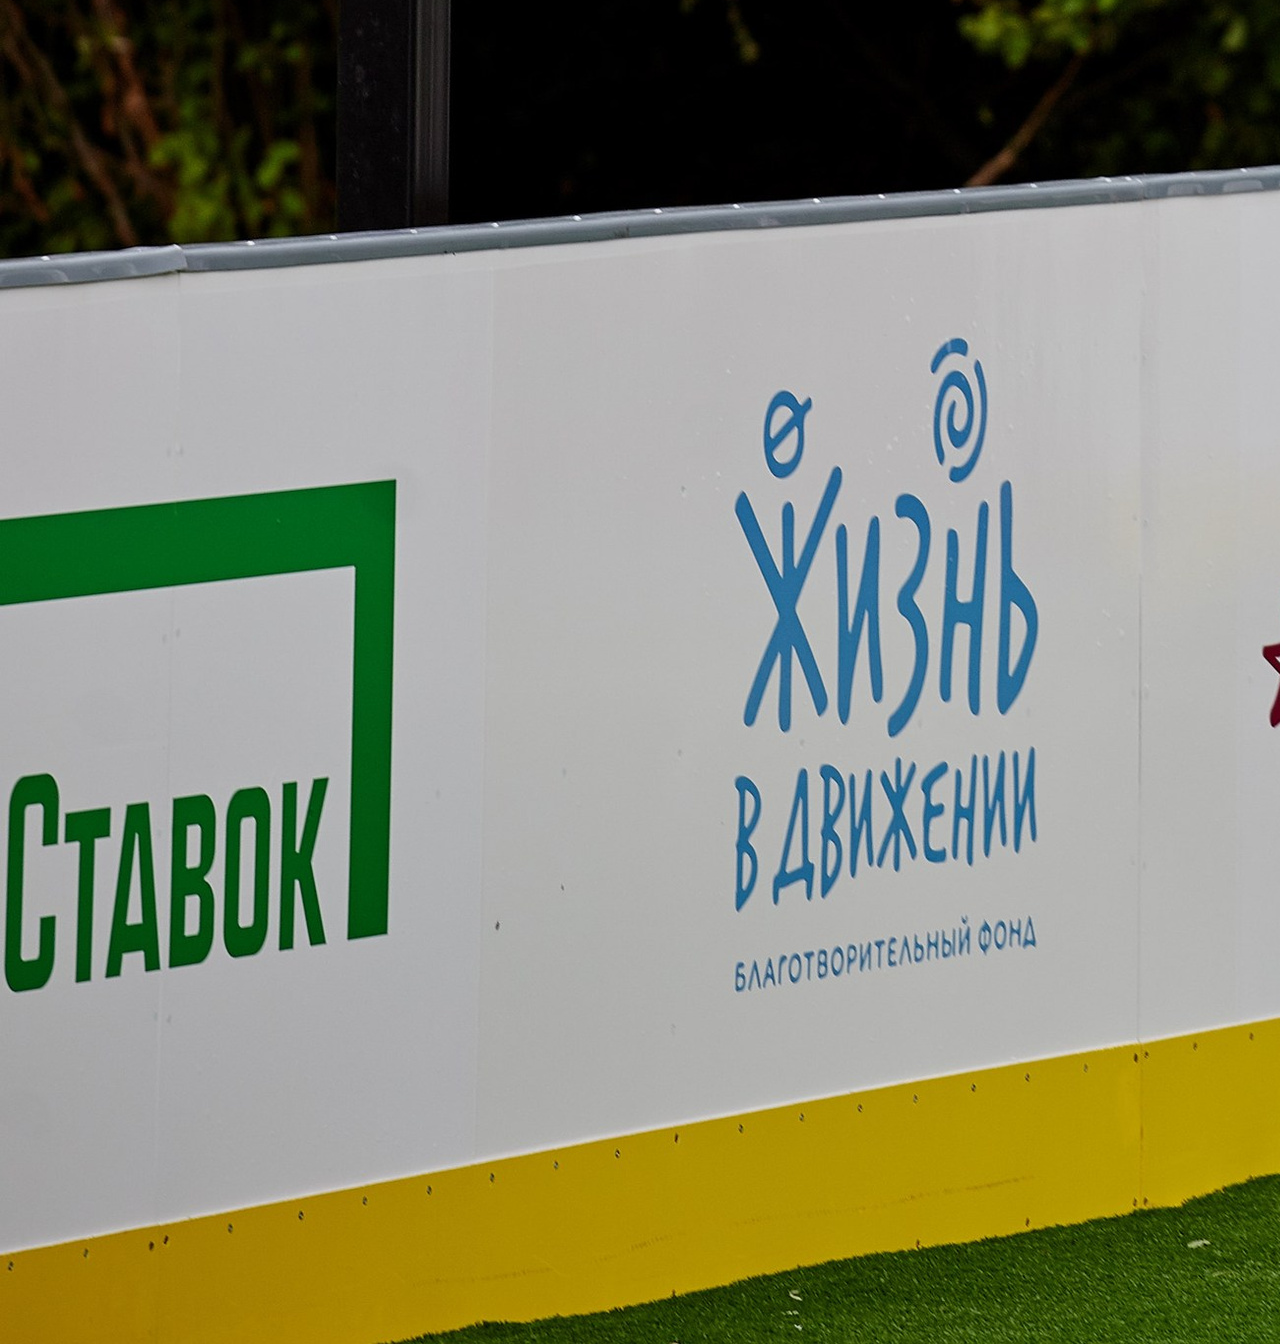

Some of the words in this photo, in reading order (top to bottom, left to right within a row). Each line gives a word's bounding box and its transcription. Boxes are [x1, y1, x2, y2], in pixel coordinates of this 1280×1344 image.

[734, 465, 1039, 738] ЖИЗНЬ
[734, 775, 763, 913] В
[772, 746, 1038, 906] ДВИЖЕНИИ
[734, 915, 972, 993] БЛАГОТВОРИТЕЛЬНЫЙ
[978, 915, 1038, 956] ФОНД
